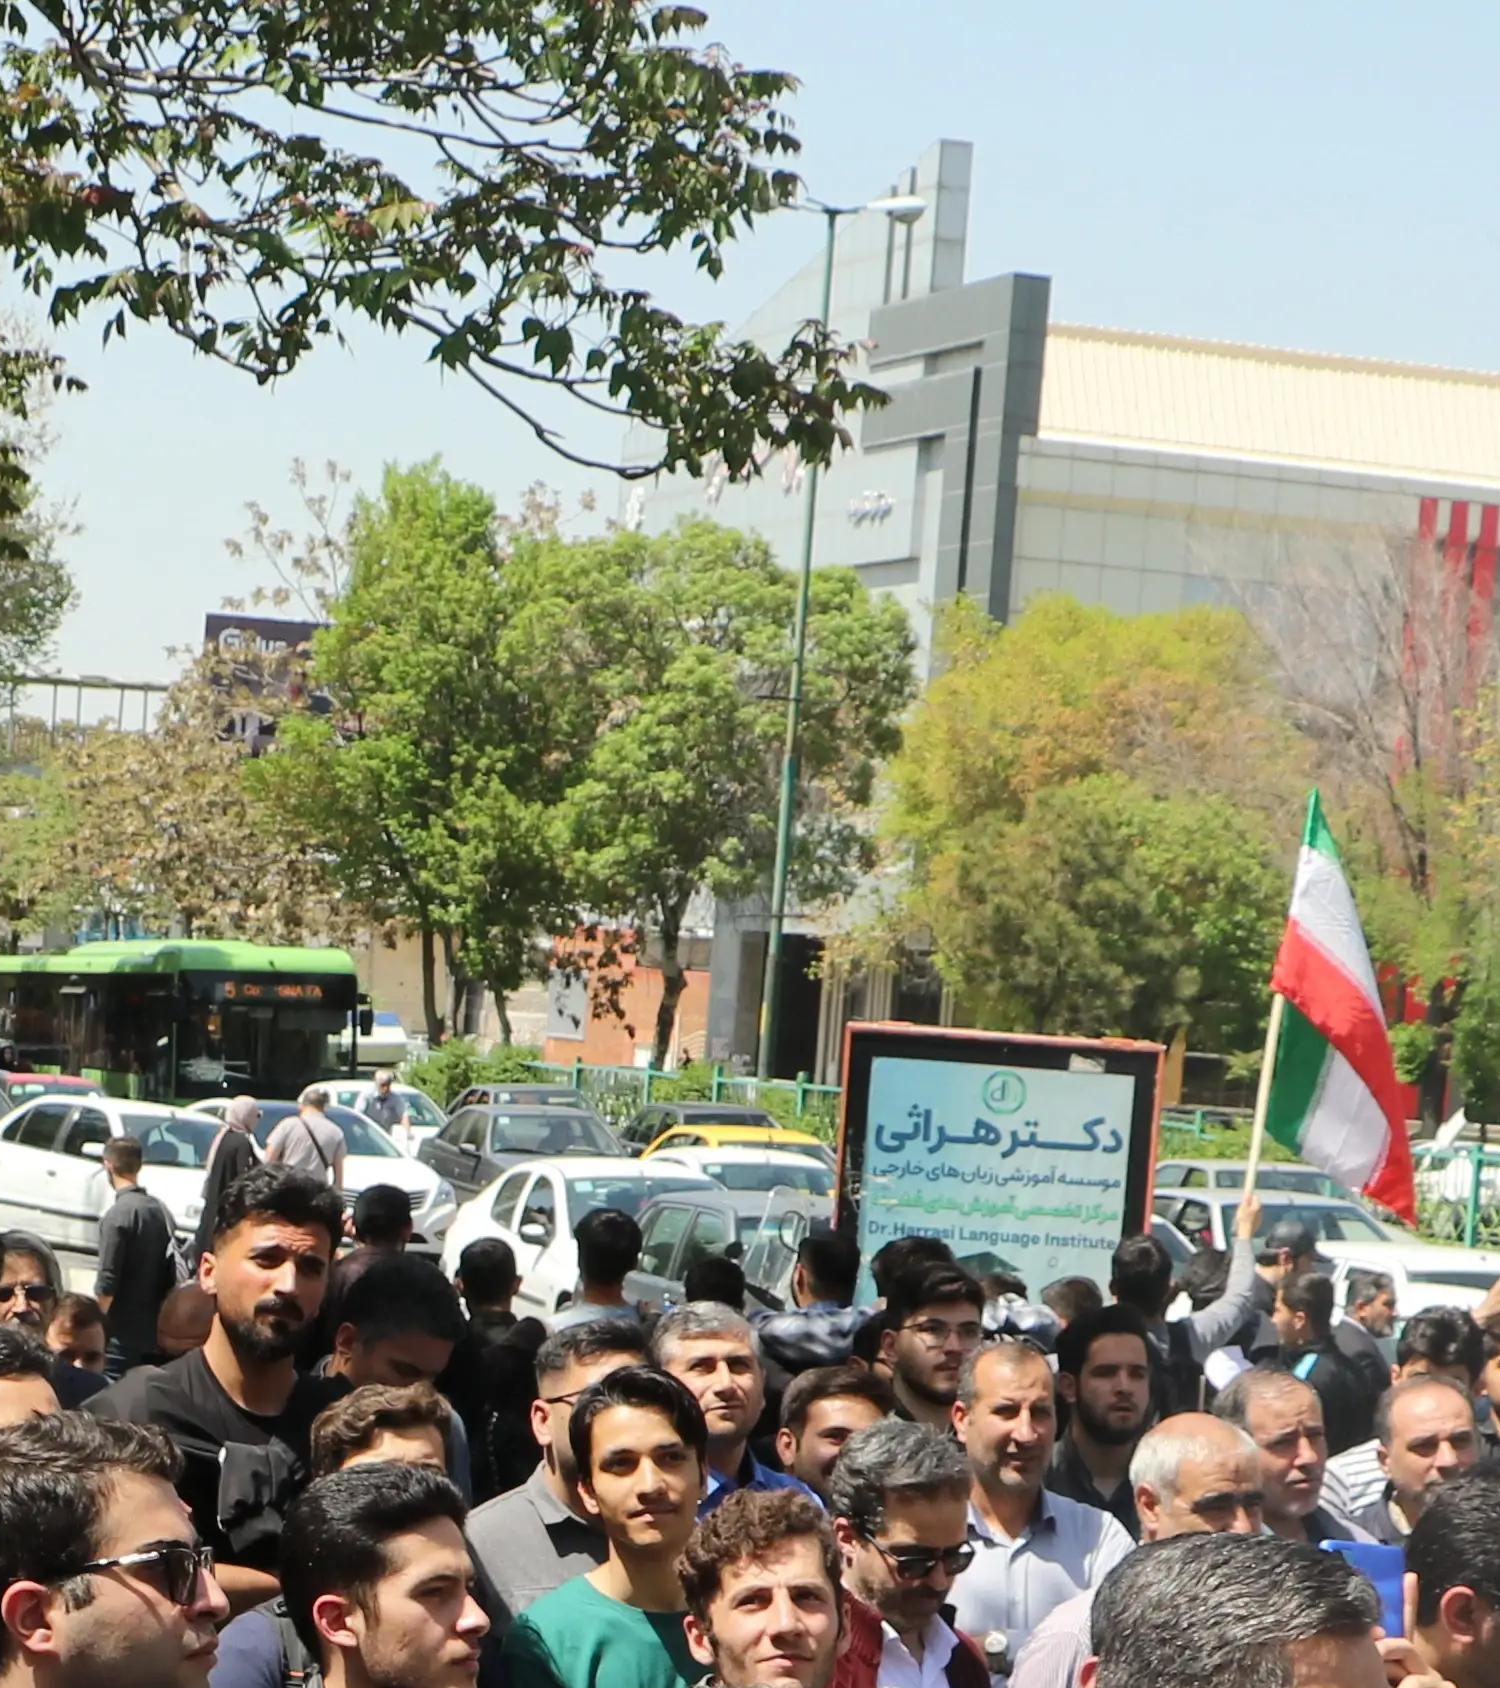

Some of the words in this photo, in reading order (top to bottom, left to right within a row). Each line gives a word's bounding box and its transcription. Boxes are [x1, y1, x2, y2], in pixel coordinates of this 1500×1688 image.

[875, 1103, 1001, 1155] هراثی
[1000, 1116, 1124, 1160] دکتر
[925, 1162, 961, 1182] های
[960, 1163, 994, 1185] زبان
[995, 1164, 1056, 1188] آموزشی
[1057, 1172, 1121, 1193] موسسه
[958, 1227, 1041, 1248] Language
[1045, 1232, 1117, 1251] Institute
